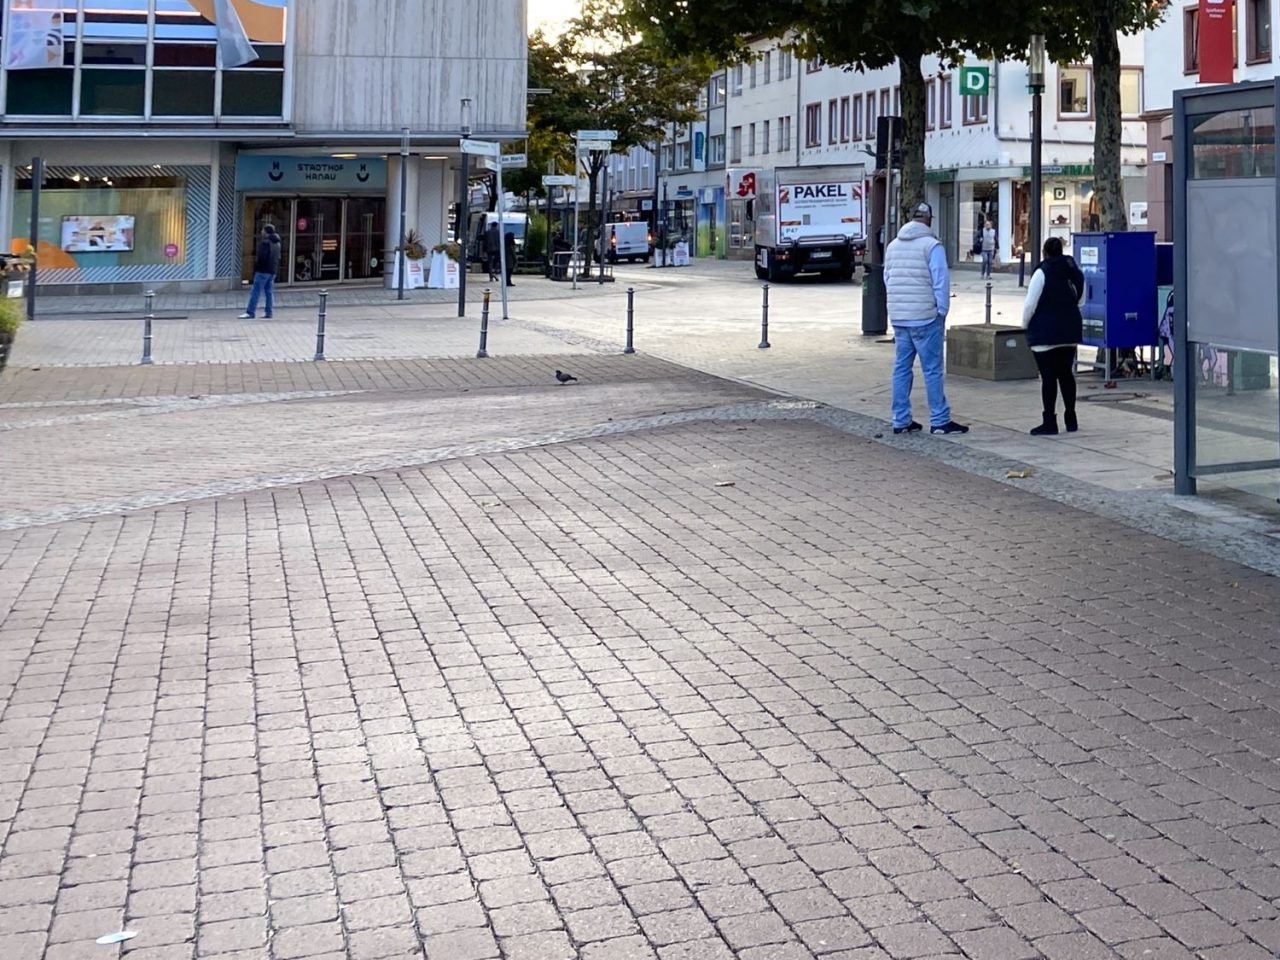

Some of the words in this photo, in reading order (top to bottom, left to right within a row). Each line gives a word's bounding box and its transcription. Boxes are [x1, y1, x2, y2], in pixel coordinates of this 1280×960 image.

[967, 72, 985, 90] D
[297, 163, 345, 172] STADTHOF
[305, 173, 337, 181] HANAU
[794, 185, 847, 199] PAKEL
